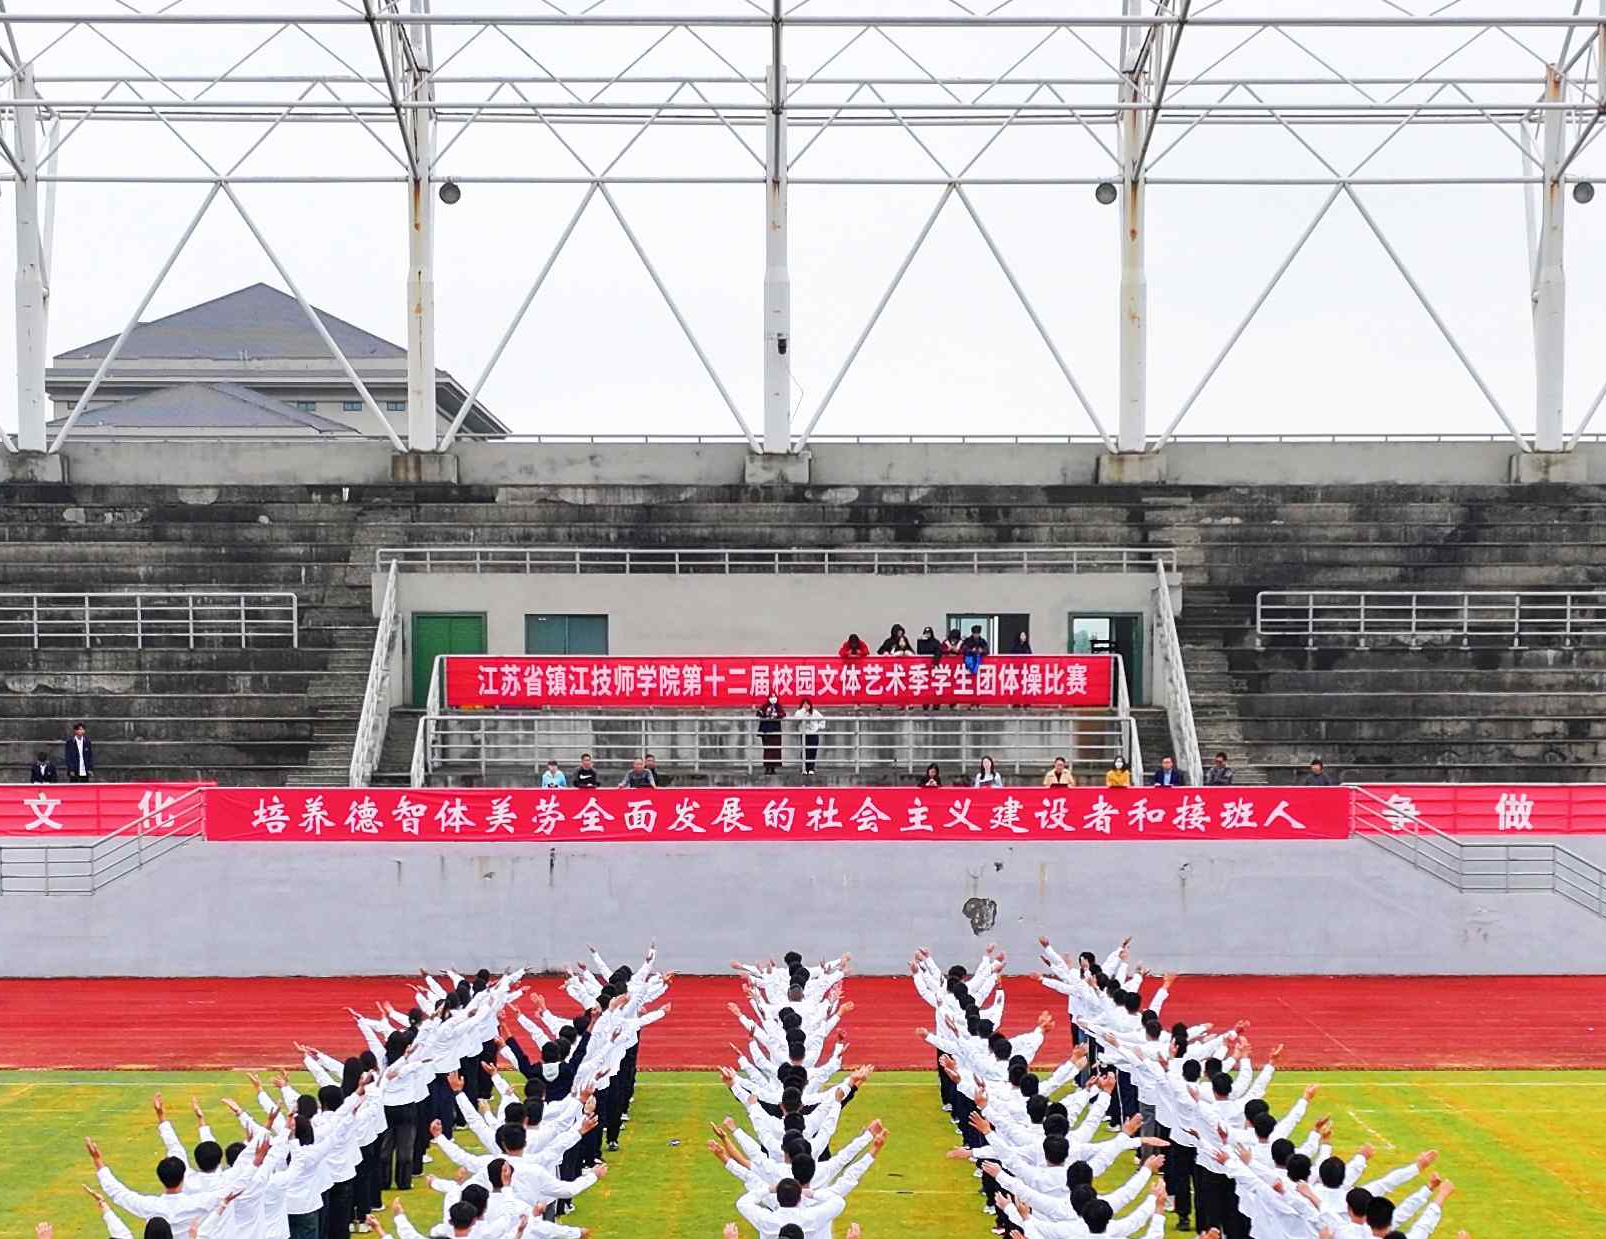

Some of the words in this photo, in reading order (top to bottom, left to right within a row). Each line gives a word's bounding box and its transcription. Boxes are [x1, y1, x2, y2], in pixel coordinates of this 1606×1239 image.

[478, 663, 1087, 697] 江苏省镇江技师学院第十二届校园文体艺术季学生团体操比赛
[251, 795, 1306, 835] 培养德智体美劳全面发展的社会主义建设者和接班人
